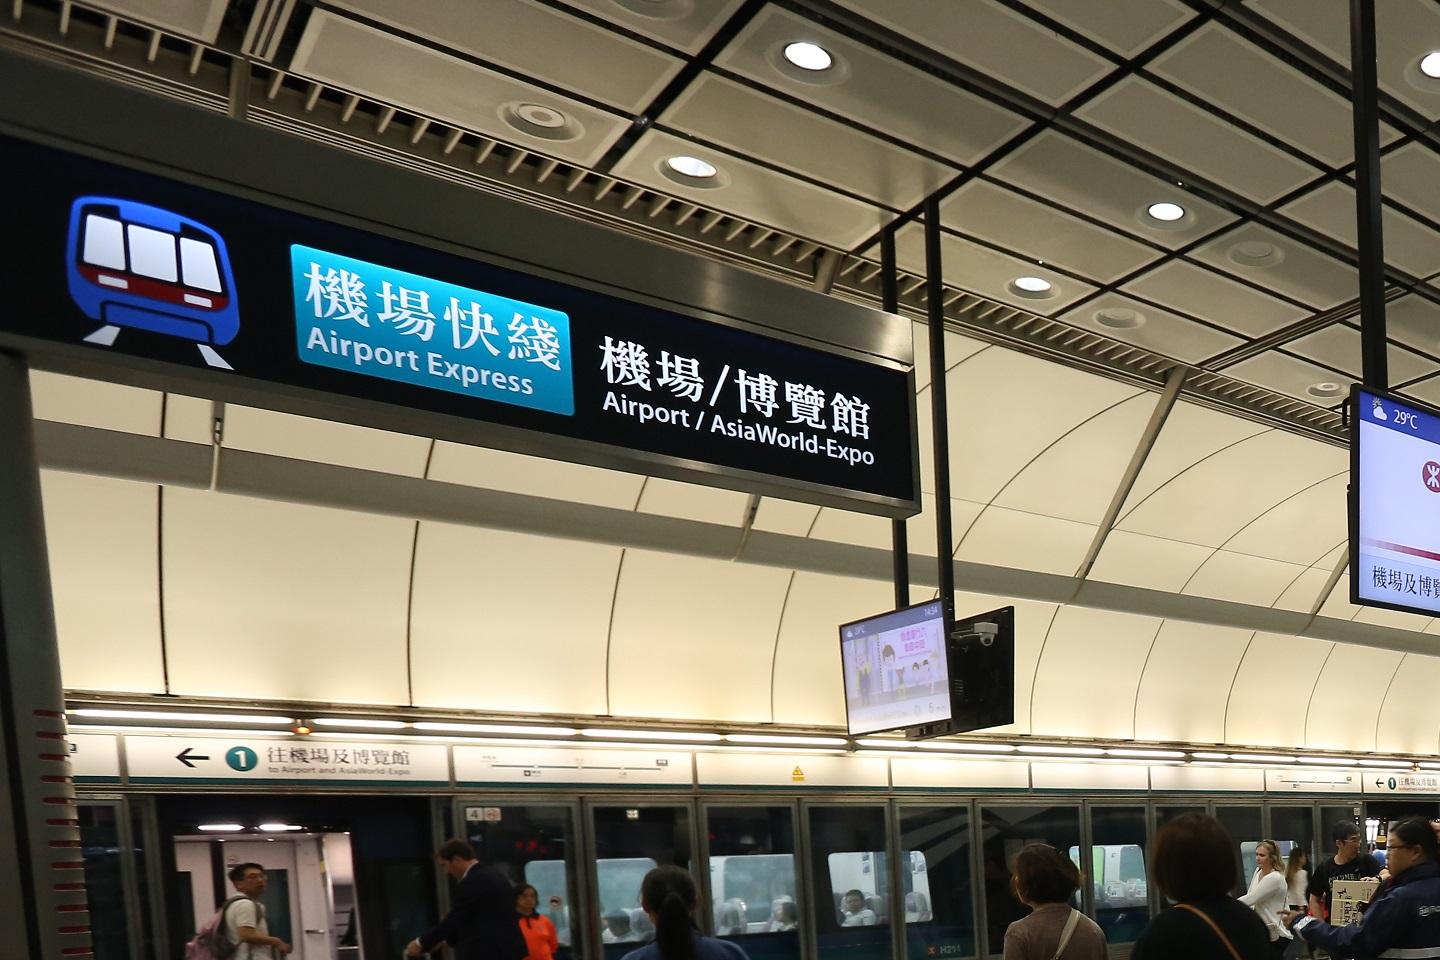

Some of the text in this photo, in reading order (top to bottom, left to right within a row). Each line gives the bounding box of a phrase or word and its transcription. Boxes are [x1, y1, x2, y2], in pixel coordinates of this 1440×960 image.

[304, 261, 561, 371] 機場快綫
[307, 327, 534, 395] Airport Express
[603, 391, 875, 466] Airport / AsiaWorld-Expo
[1393, 409, 1418, 430] 29°C
[282, 766, 316, 775] Airport
[470, 809, 479, 818] 4
